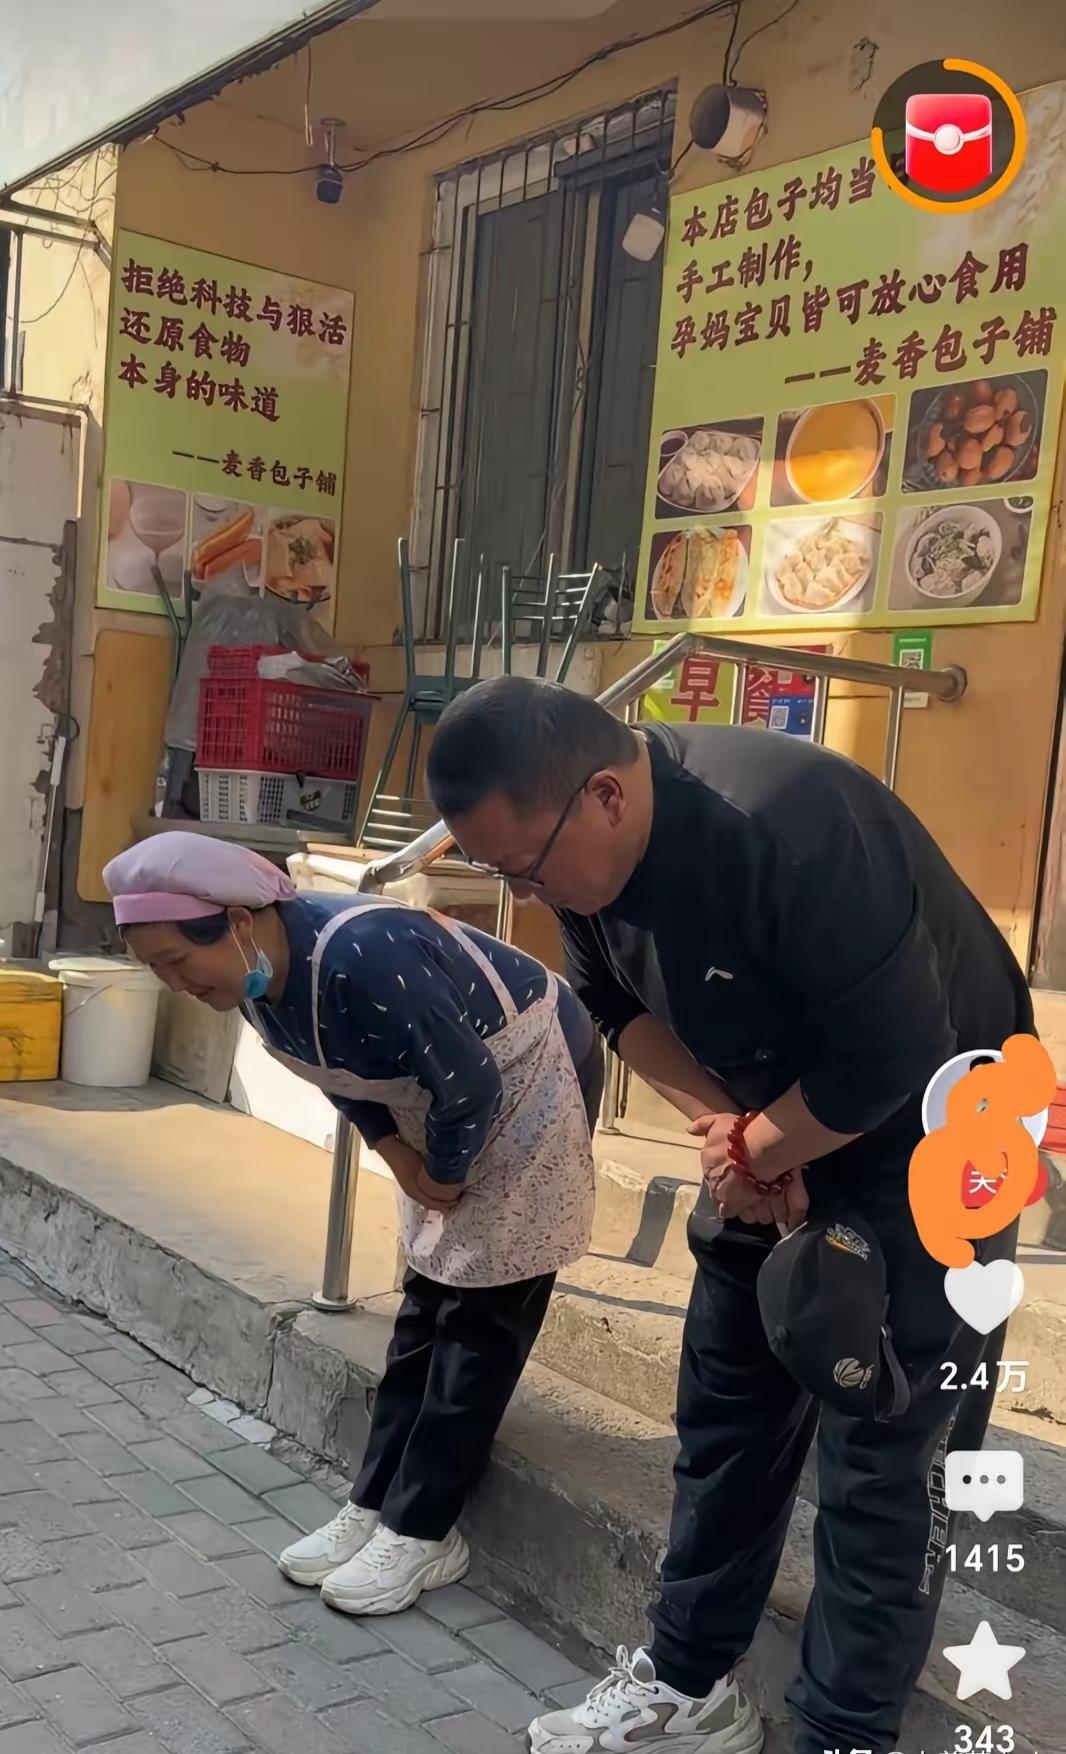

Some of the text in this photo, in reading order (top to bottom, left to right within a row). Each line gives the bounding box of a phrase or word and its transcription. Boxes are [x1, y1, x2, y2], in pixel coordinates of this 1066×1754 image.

[119, 307, 252, 368] 还原食物
[121, 258, 347, 346] 拒绝科技与狠活
[670, 242, 1029, 359] 孕妈宝贝皆可放心食用
[117, 353, 280, 422] 本身的味道
